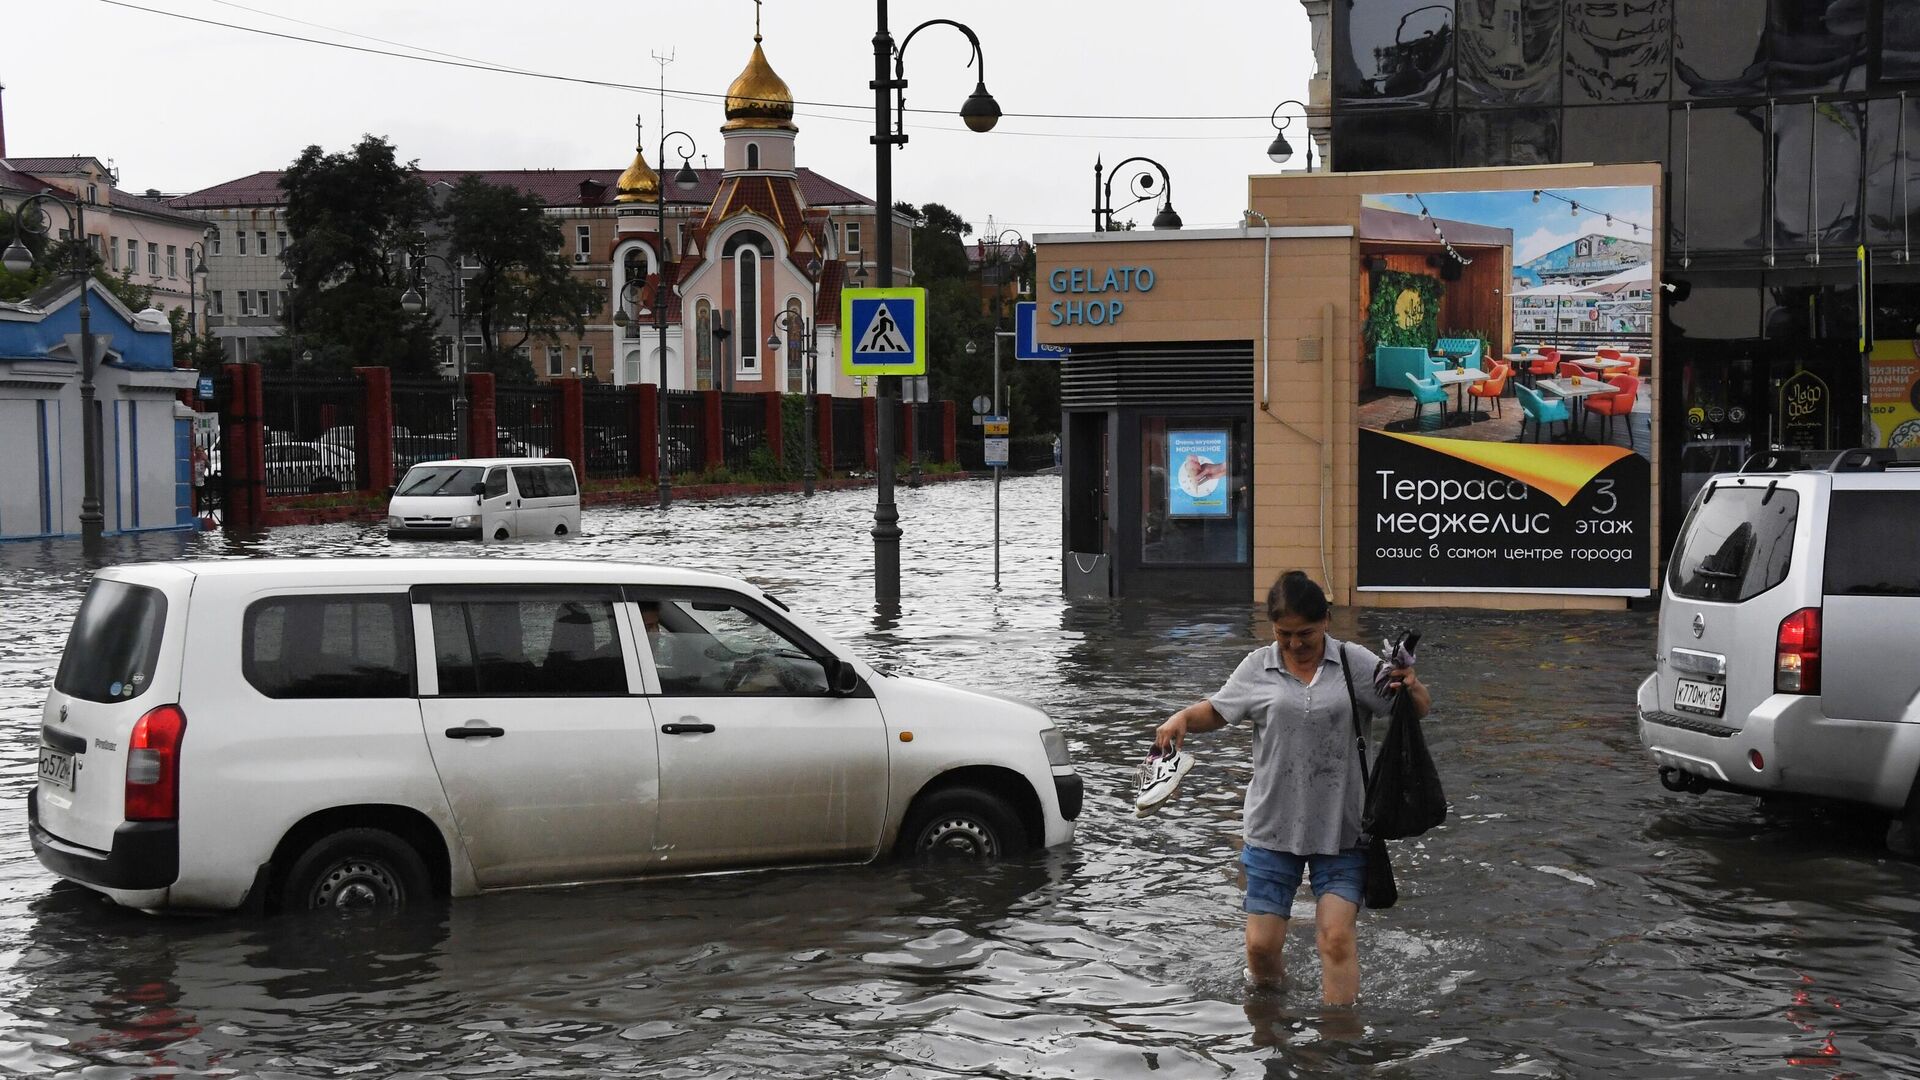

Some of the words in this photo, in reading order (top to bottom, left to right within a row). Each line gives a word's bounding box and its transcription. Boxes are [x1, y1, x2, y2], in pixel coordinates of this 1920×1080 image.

[1049, 266, 1156, 292] GELATO
[1050, 299, 1124, 326] SHOP
[1376, 470, 1528, 505] Терраса
[1591, 479, 1618, 515] 3
[1376, 512, 1550, 539] меджелис
[1575, 519, 1633, 534] этаж
[1375, 547, 1422, 559] оазис
[1429, 544, 1440, 559] в
[1447, 547, 1497, 559] самом
[1504, 547, 1563, 561] центре
[1571, 547, 1633, 562] города
[1709, 687, 1722, 702] 125
